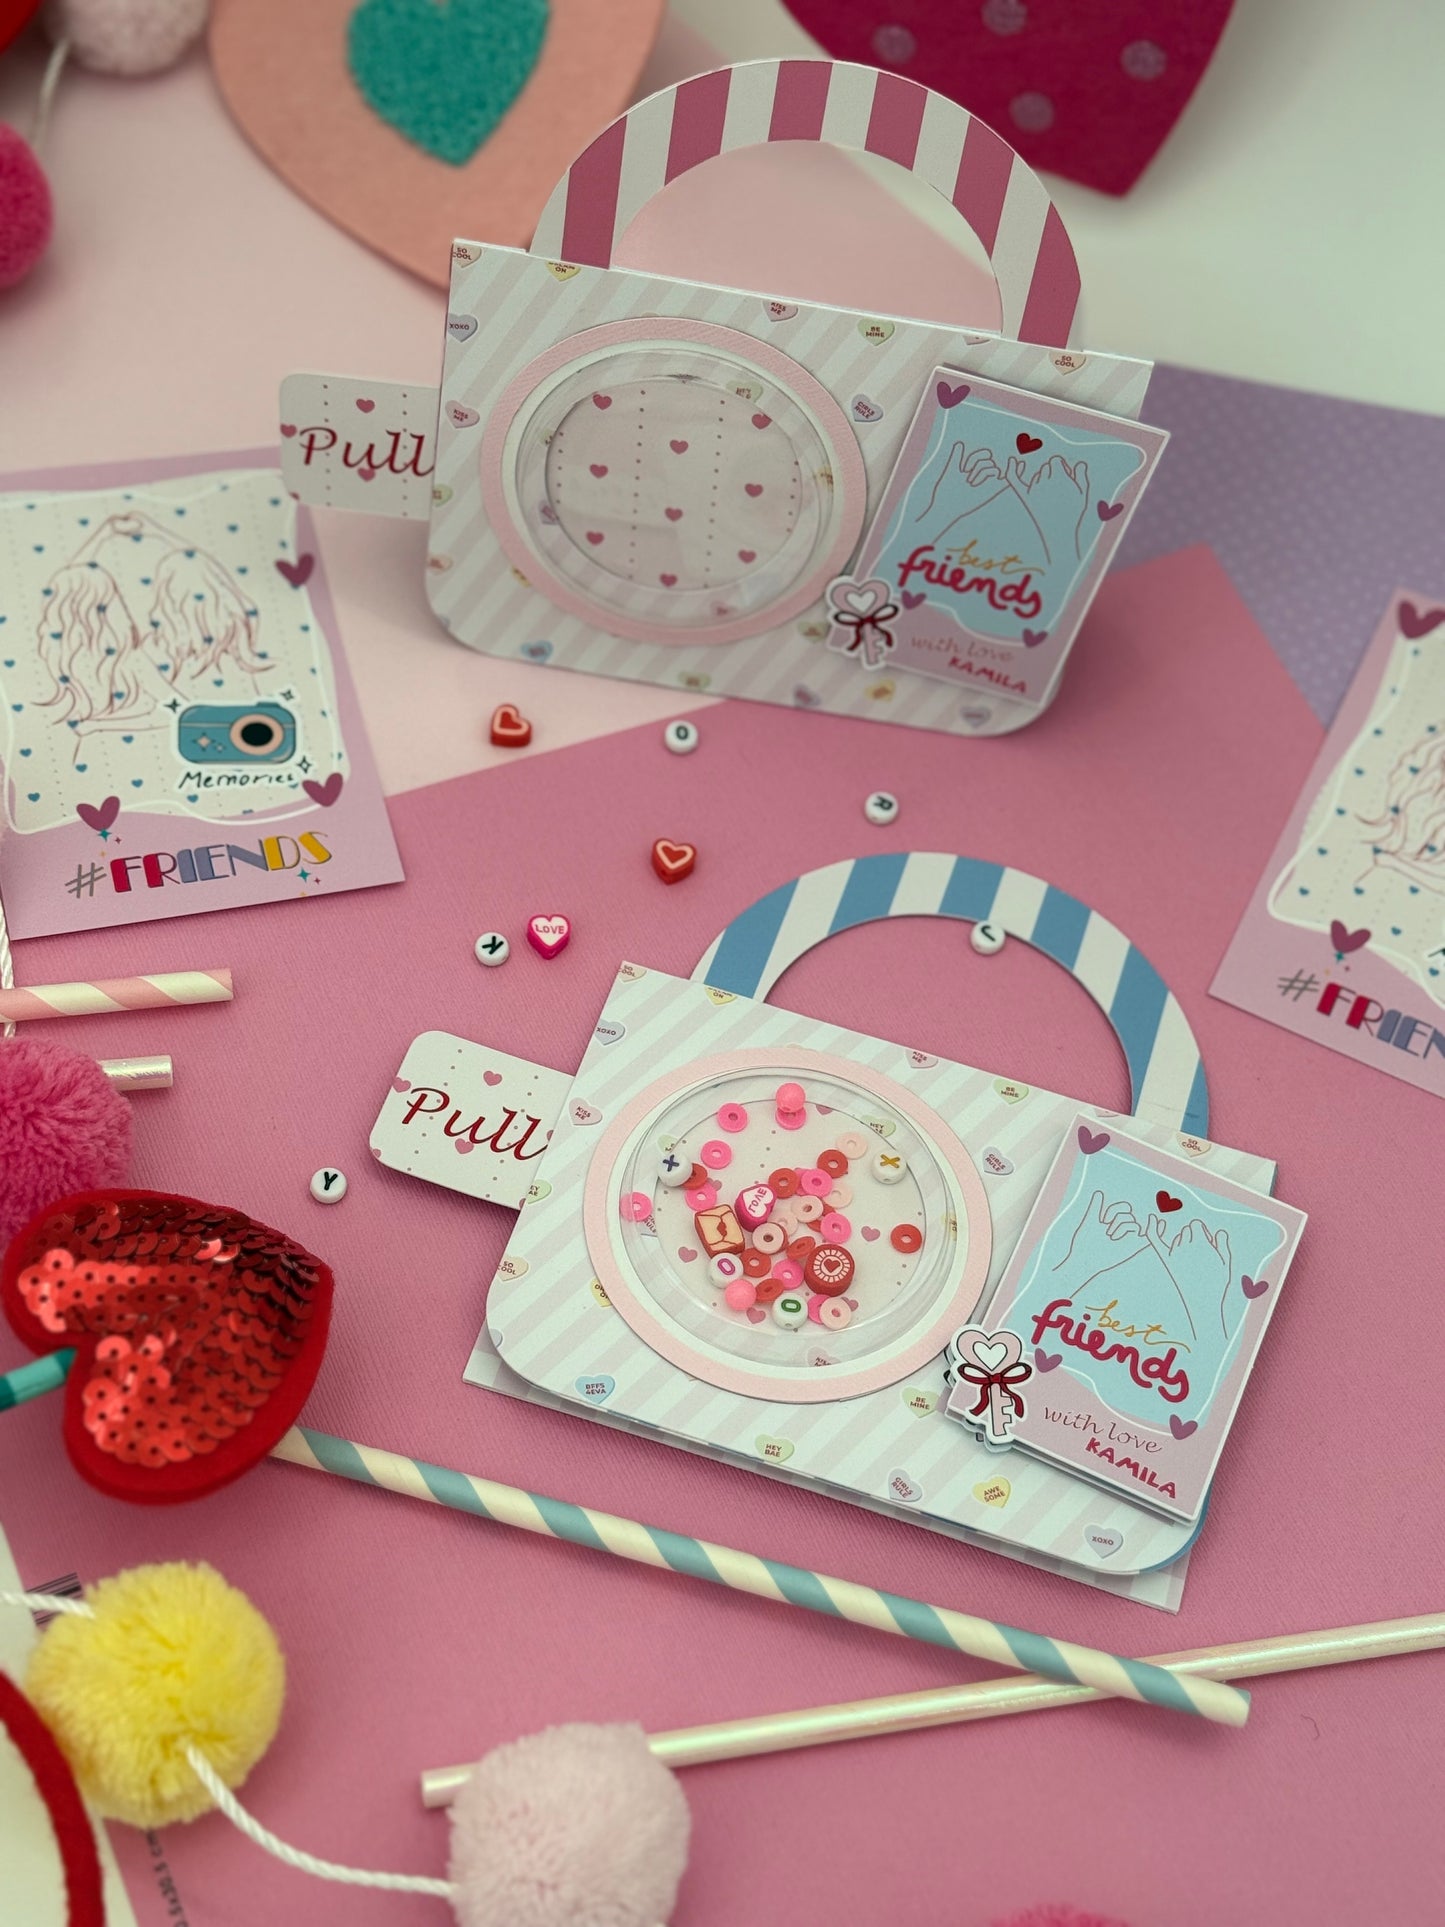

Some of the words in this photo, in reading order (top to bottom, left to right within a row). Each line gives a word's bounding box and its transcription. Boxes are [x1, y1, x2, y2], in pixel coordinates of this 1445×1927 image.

[770, 306, 782, 315] ME
[449, 323, 470, 331] XOXO
[1055, 359, 1076, 368] COOL
[854, 404, 871, 419] RULE
[299, 426, 435, 477] Pull
[946, 539, 1045, 577] best
[898, 545, 1042, 619] friends
[911, 634, 961, 655] with
[968, 639, 1014, 662] love
[948, 656, 1027, 694] KAMILA
[179, 771, 296, 790] Memories
[873, 795, 893, 811] R
[64, 831, 333, 899] #FRIENDS
[535, 923, 565, 935] LOVE
[597, 1027, 616, 1036] XOXO
[912, 1055, 922, 1063] ME
[1000, 1090, 1020, 1098] MINE
[575, 1111, 586, 1121] ME
[576, 1106, 591, 1119] KISS
[402, 1087, 548, 1161] Pull
[1181, 1142, 1202, 1152] COOL
[1187, 1138, 1198, 1146] SO
[662, 1154, 680, 1172] X
[880, 1154, 901, 1169] X
[984, 1157, 1001, 1172] RULE
[988, 1153, 1006, 1170] GIRLS
[324, 1171, 338, 1191] Y
[748, 1187, 767, 1213] LOVE
[1085, 1299, 1191, 1354] best
[1031, 1299, 1190, 1403] friends
[586, 1382, 605, 1390] BFFS
[586, 1387, 606, 1395] 4EVA
[910, 1402, 930, 1410] MINE
[1044, 1406, 1104, 1434] with
[1108, 1421, 1163, 1453] love
[764, 1449, 781, 1457] BAE
[765, 1443, 782, 1451] HEY
[1085, 1437, 1176, 1499] KAMILA
[891, 1482, 908, 1498] RULE
[895, 1477, 914, 1495] GIRLS
[983, 1485, 1000, 1496] AWE
[984, 1491, 1005, 1503] SOME
[1092, 1536, 1114, 1546] XOXO
